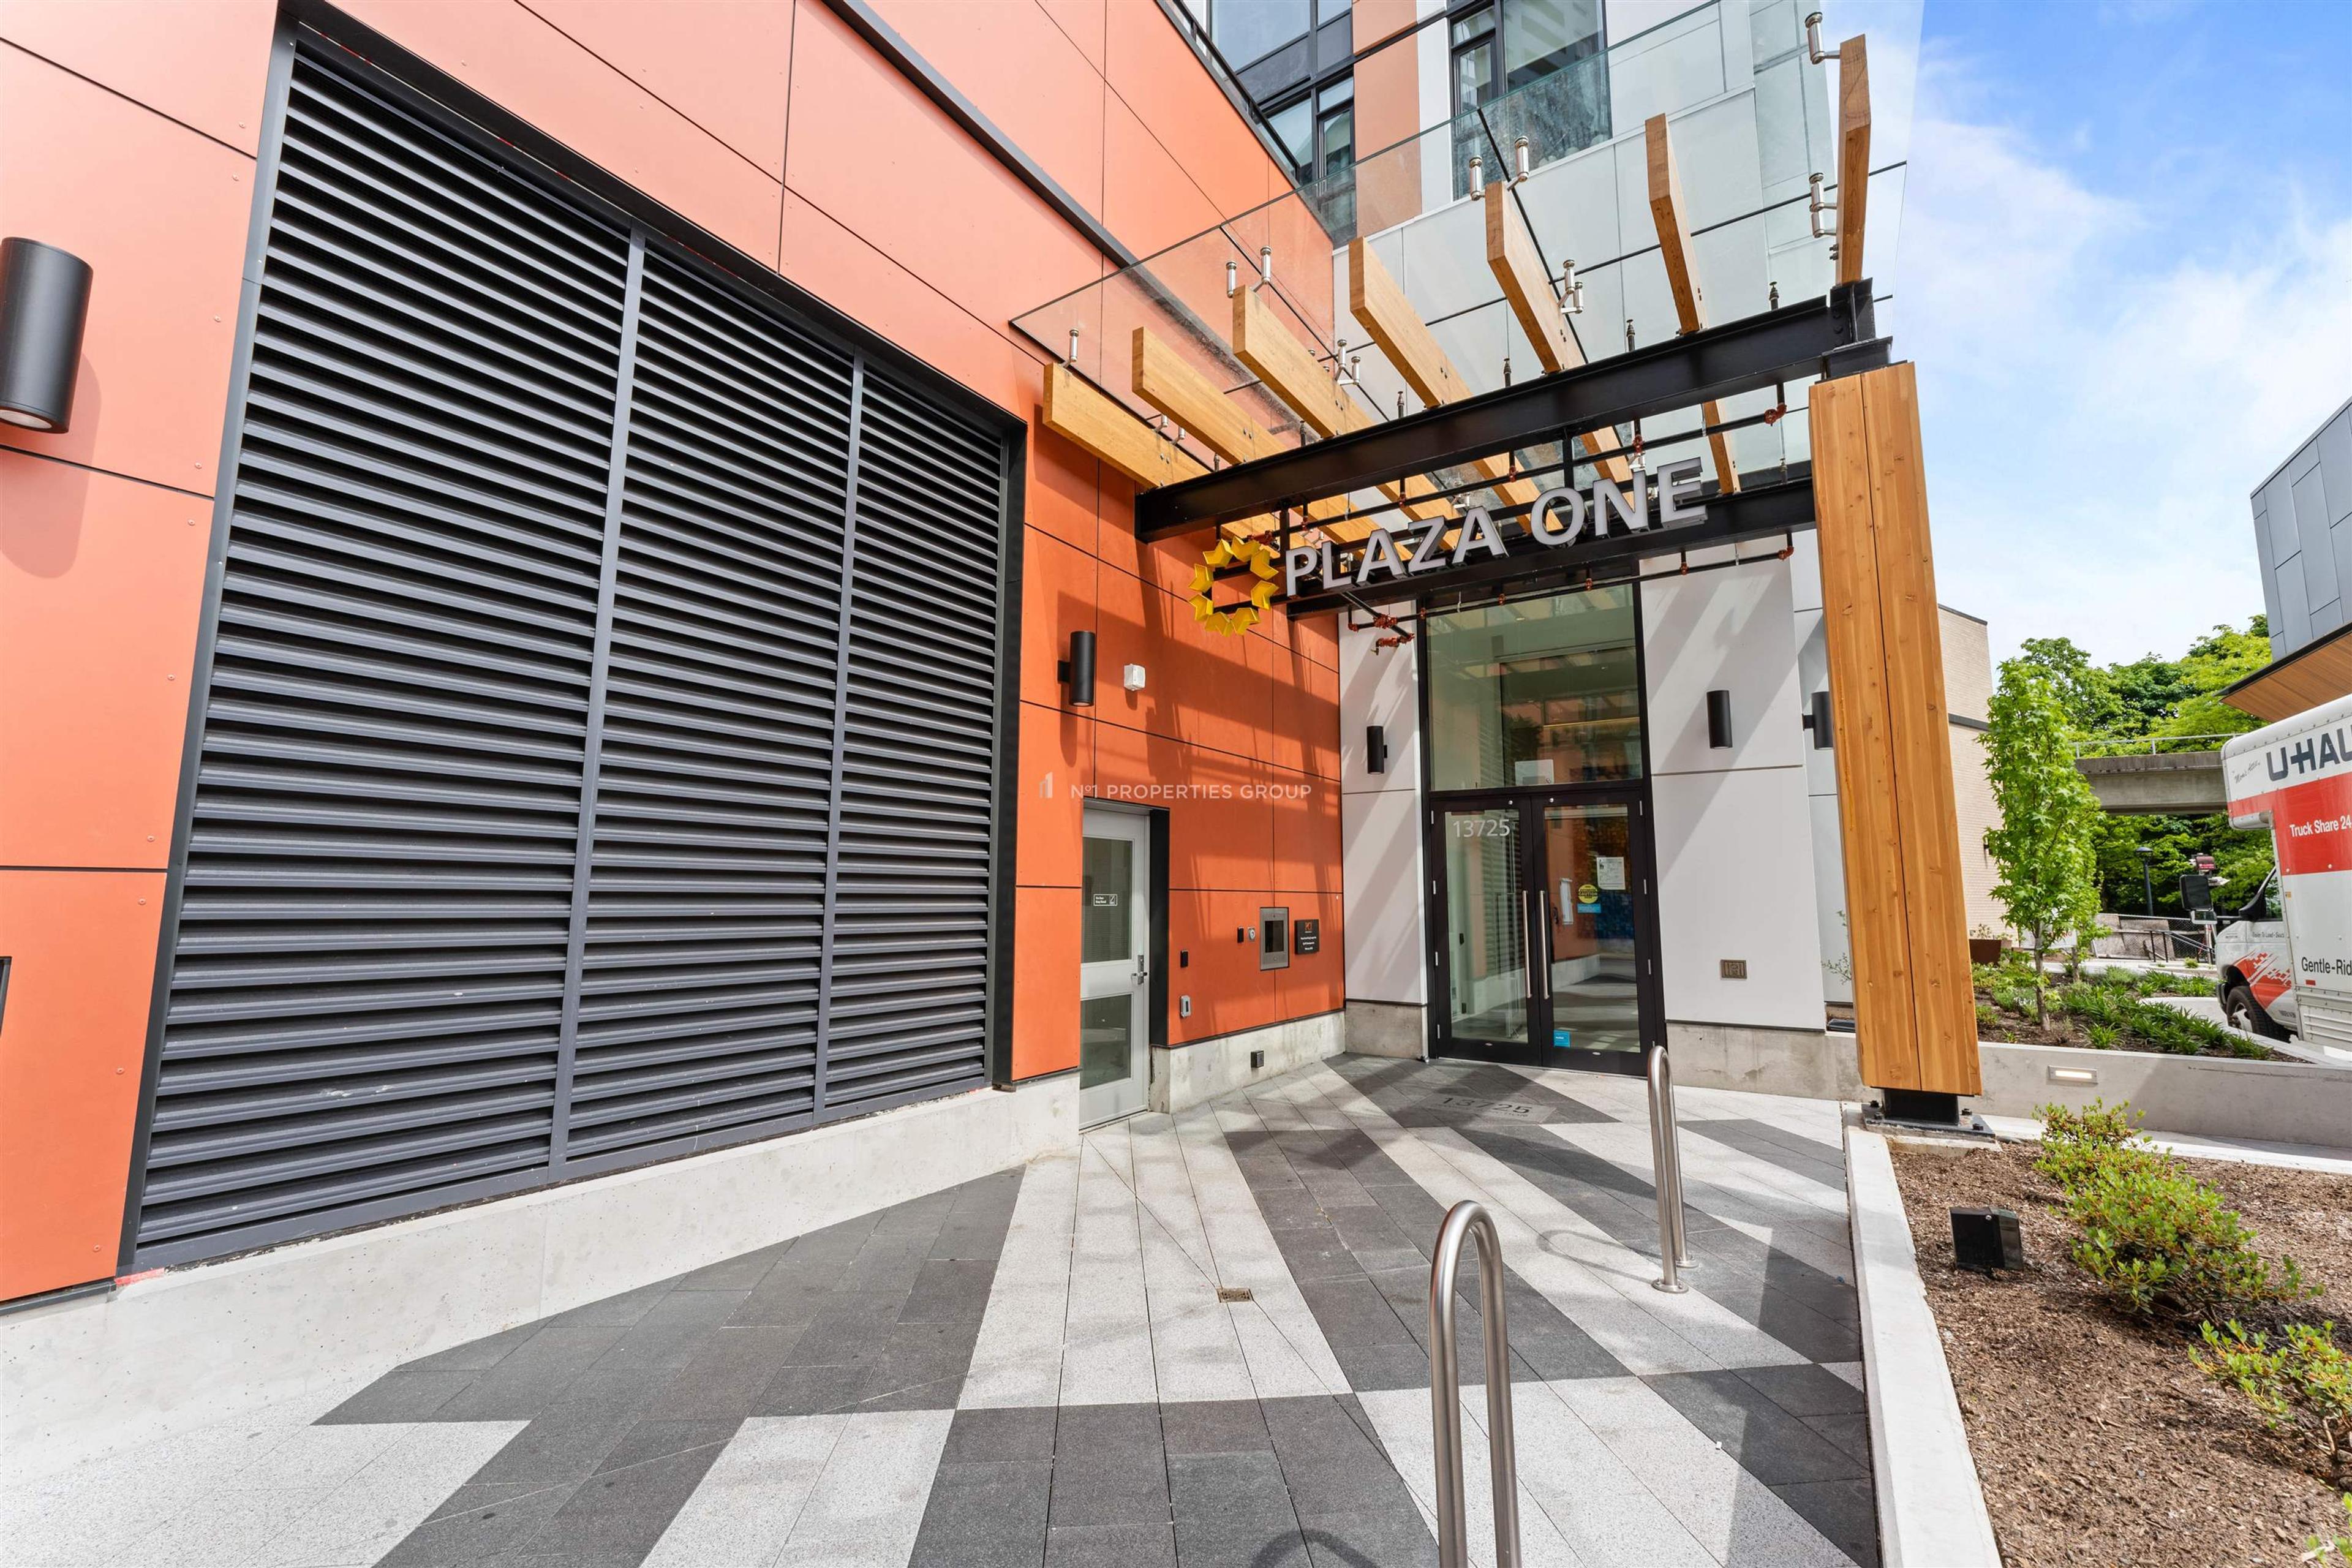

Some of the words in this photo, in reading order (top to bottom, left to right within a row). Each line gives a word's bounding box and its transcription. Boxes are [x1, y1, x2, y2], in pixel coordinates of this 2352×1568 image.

[1286, 505, 1509, 597] PLAZA
[1531, 457, 1709, 548] ONE
[1452, 818, 1510, 838] 13725
[2290, 821, 2313, 837] Truck
[2313, 819, 2339, 834] Share
[1443, 1097, 1532, 1114] 13725
